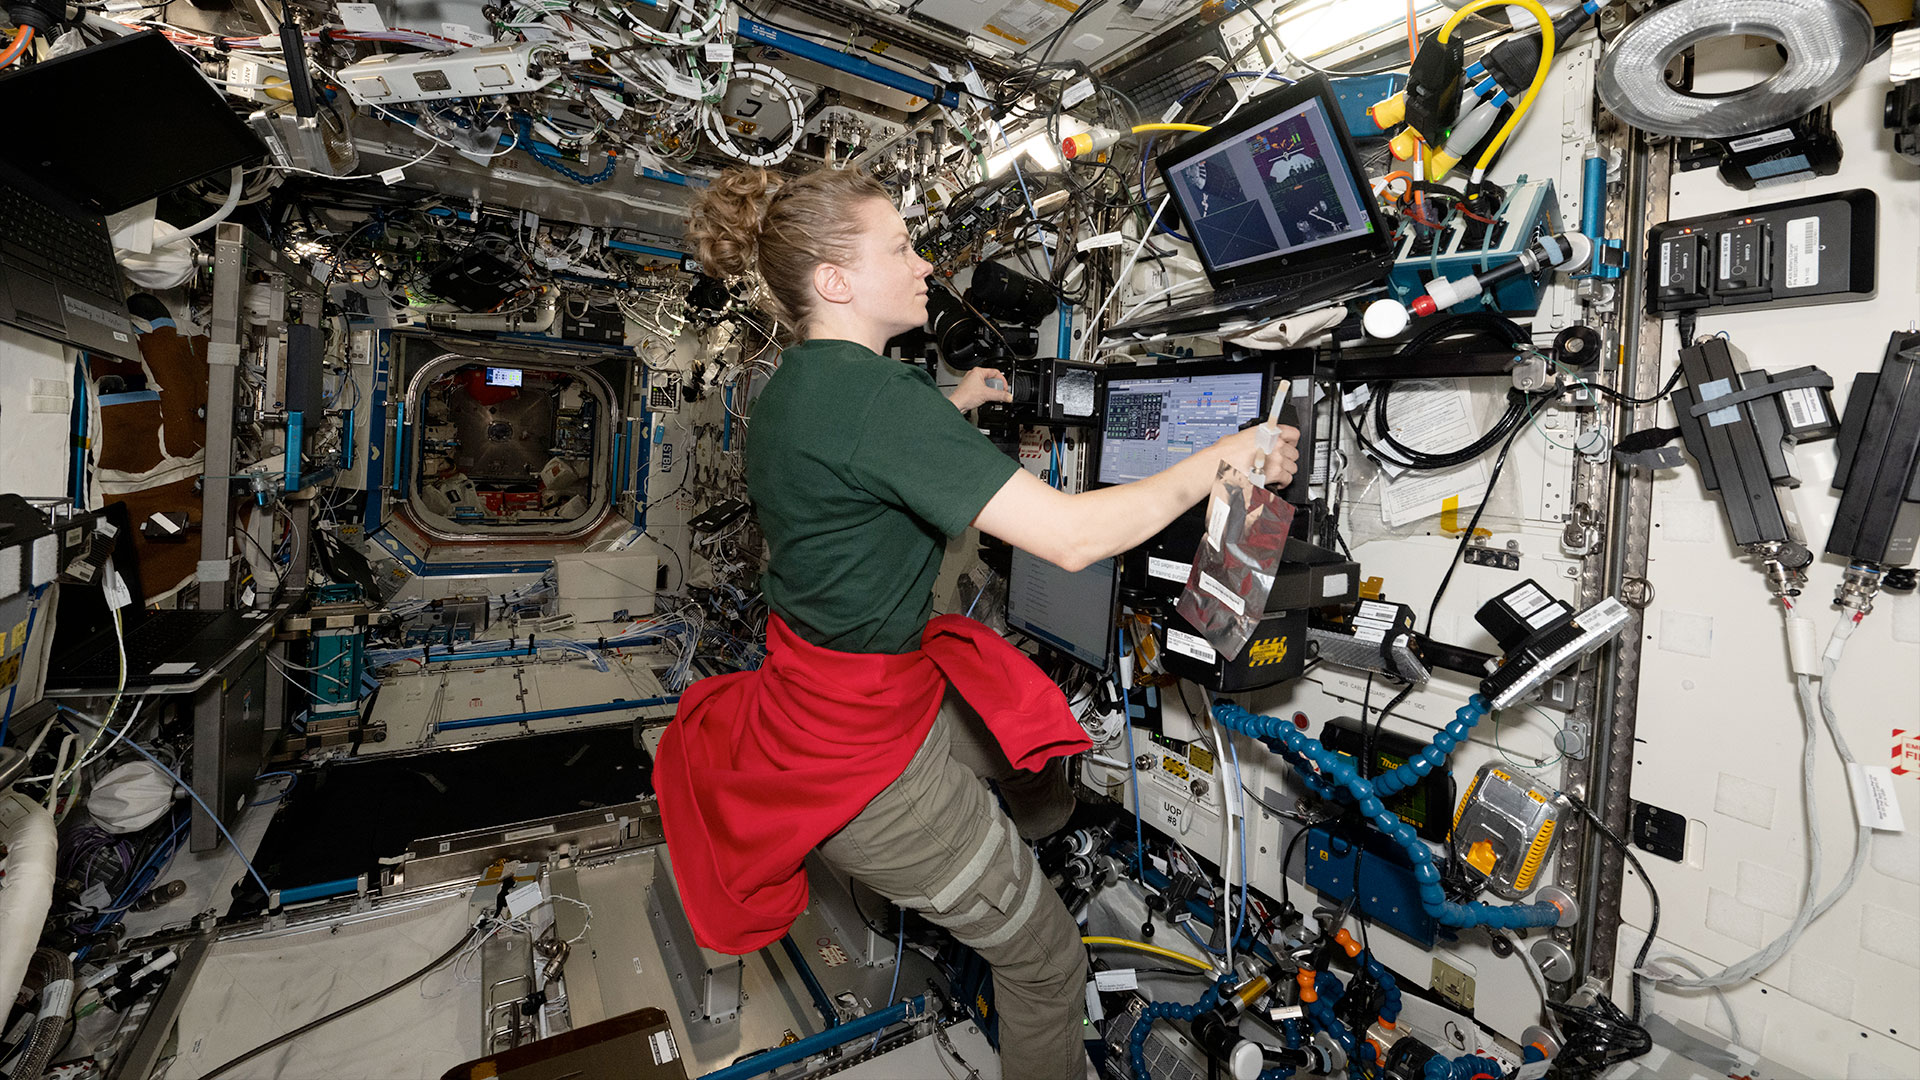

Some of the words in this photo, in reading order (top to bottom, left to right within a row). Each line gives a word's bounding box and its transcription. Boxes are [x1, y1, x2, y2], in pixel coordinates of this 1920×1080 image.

[662, 445, 671, 471] STBD
[1414, 702, 1427, 712] SIDE
[1163, 801, 1182, 817] UOP
[1167, 815, 1177, 827] #8
